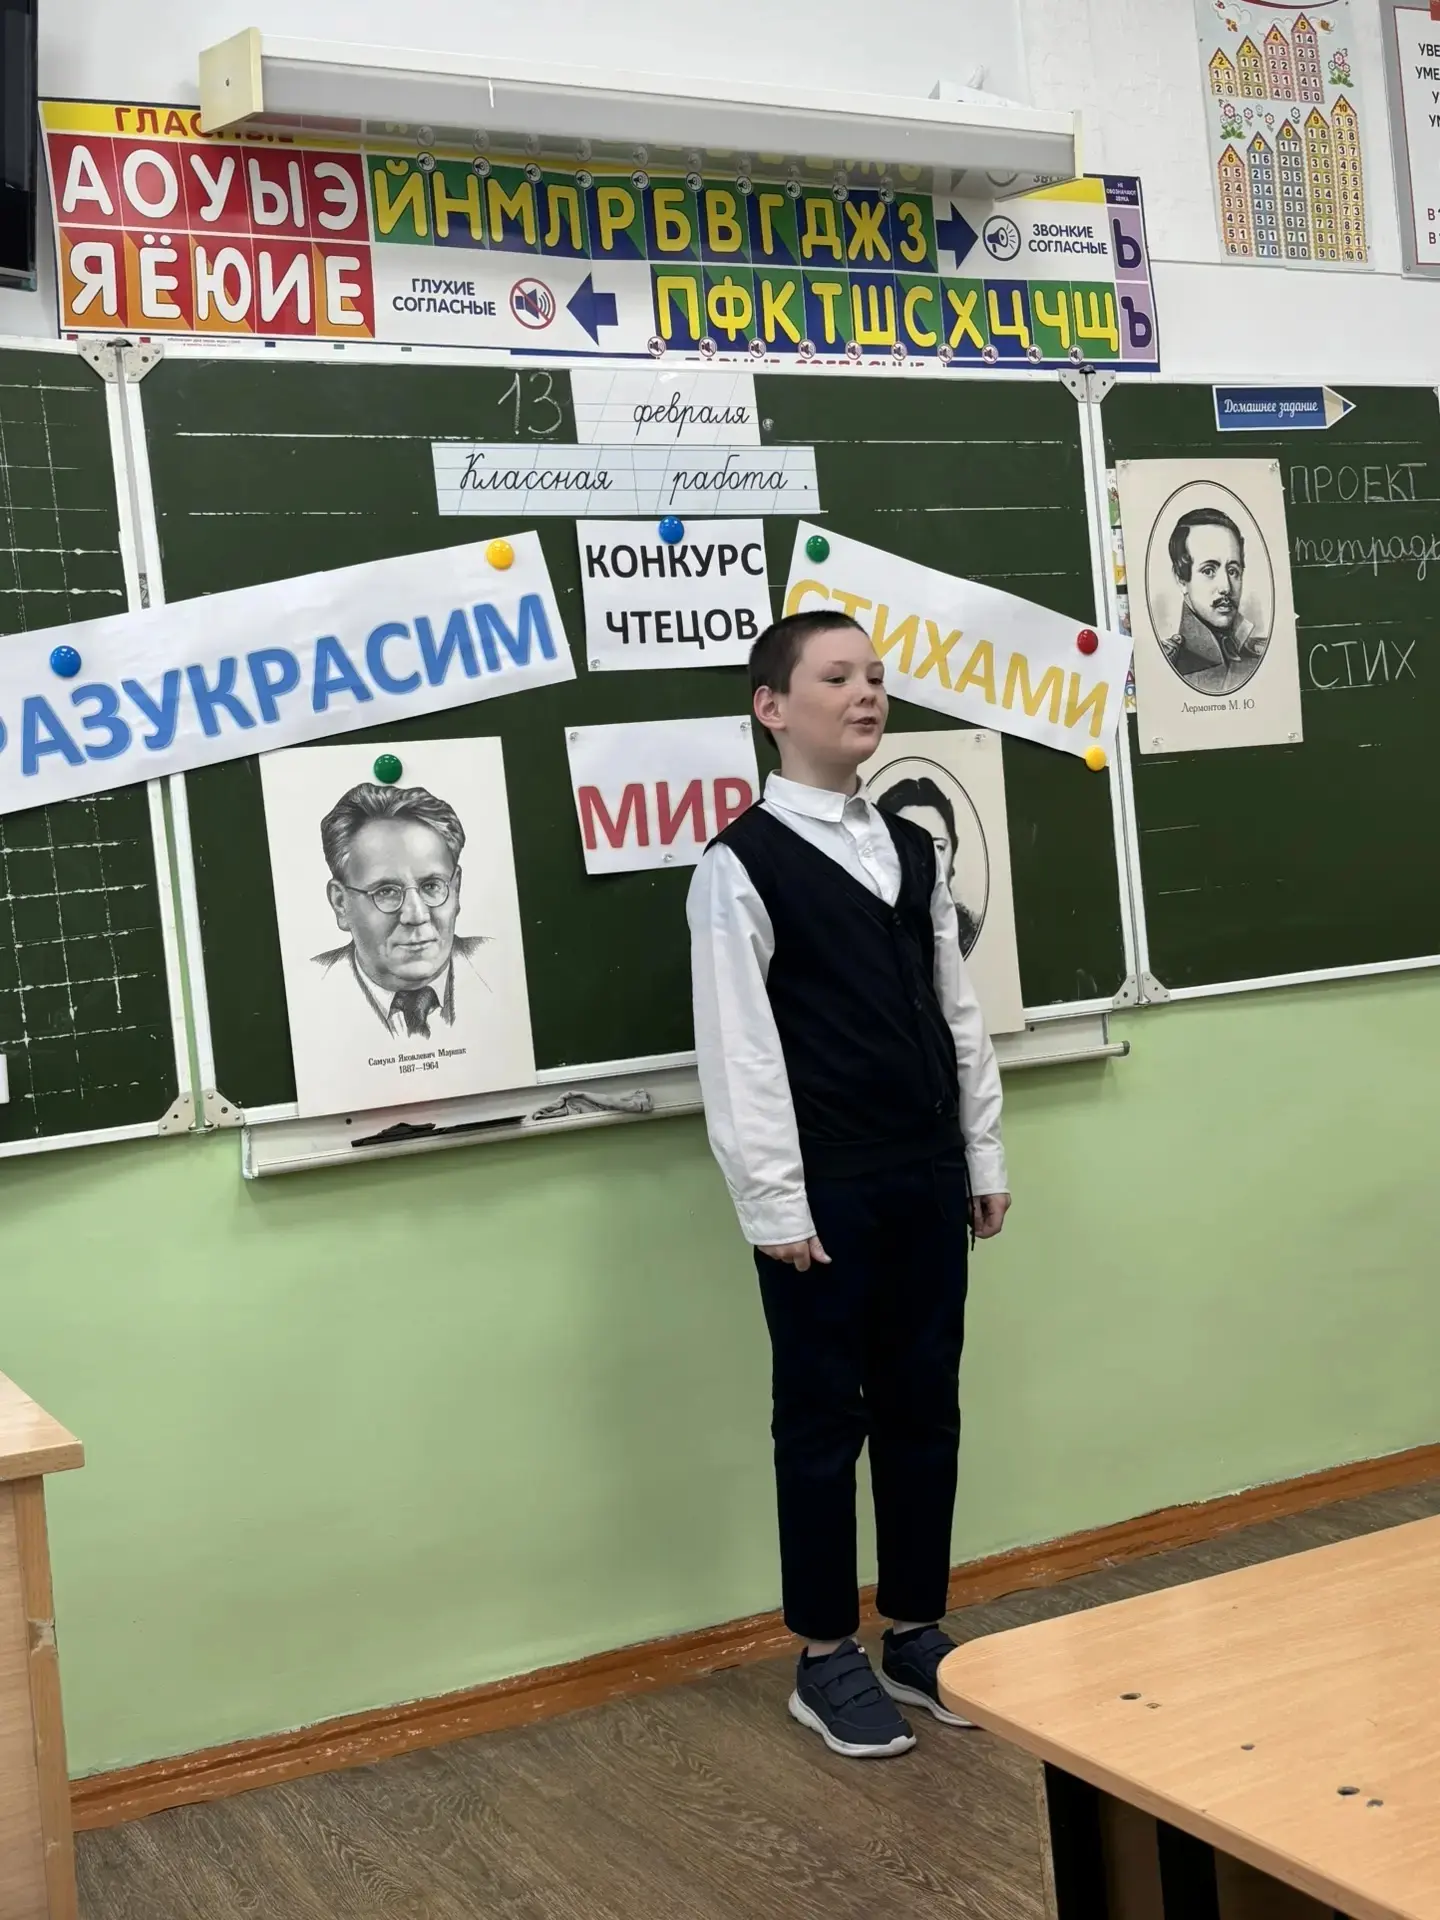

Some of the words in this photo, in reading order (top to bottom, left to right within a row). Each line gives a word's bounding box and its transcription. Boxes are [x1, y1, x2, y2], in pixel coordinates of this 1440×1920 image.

[1028, 239, 1108, 255] СОГЛАСНЫЕ
[1032, 224, 1094, 239] ЗВОНКИЕ
[411, 278, 475, 296] ГЛУХИЕ
[392, 296, 496, 316] СОГЛАСНЫЕ
[498, 372, 562, 435] 13
[634, 392, 750, 437] февраля
[1224, 399, 1276, 414] Домашнее
[1278, 400, 1318, 418] задание
[460, 453, 612, 490] Классная
[670, 454, 788, 505] работа
[1290, 462, 1427, 504] ПРОЕКТ
[586, 544, 764, 578] КОНКУРС
[606, 608, 758, 649] ЧТЕЦОВ
[1308, 639, 1416, 688] СТИХ
[0, 593, 558, 776] АЗУКРАСИМ
[1181, 702, 1226, 714] Лермонтов
[578, 778, 754, 849] МИР
[368, 1057, 396, 1066] Самуил
[398, 1052, 435, 1063] Яковлевич
[438, 1047, 466, 1058] Маршак
